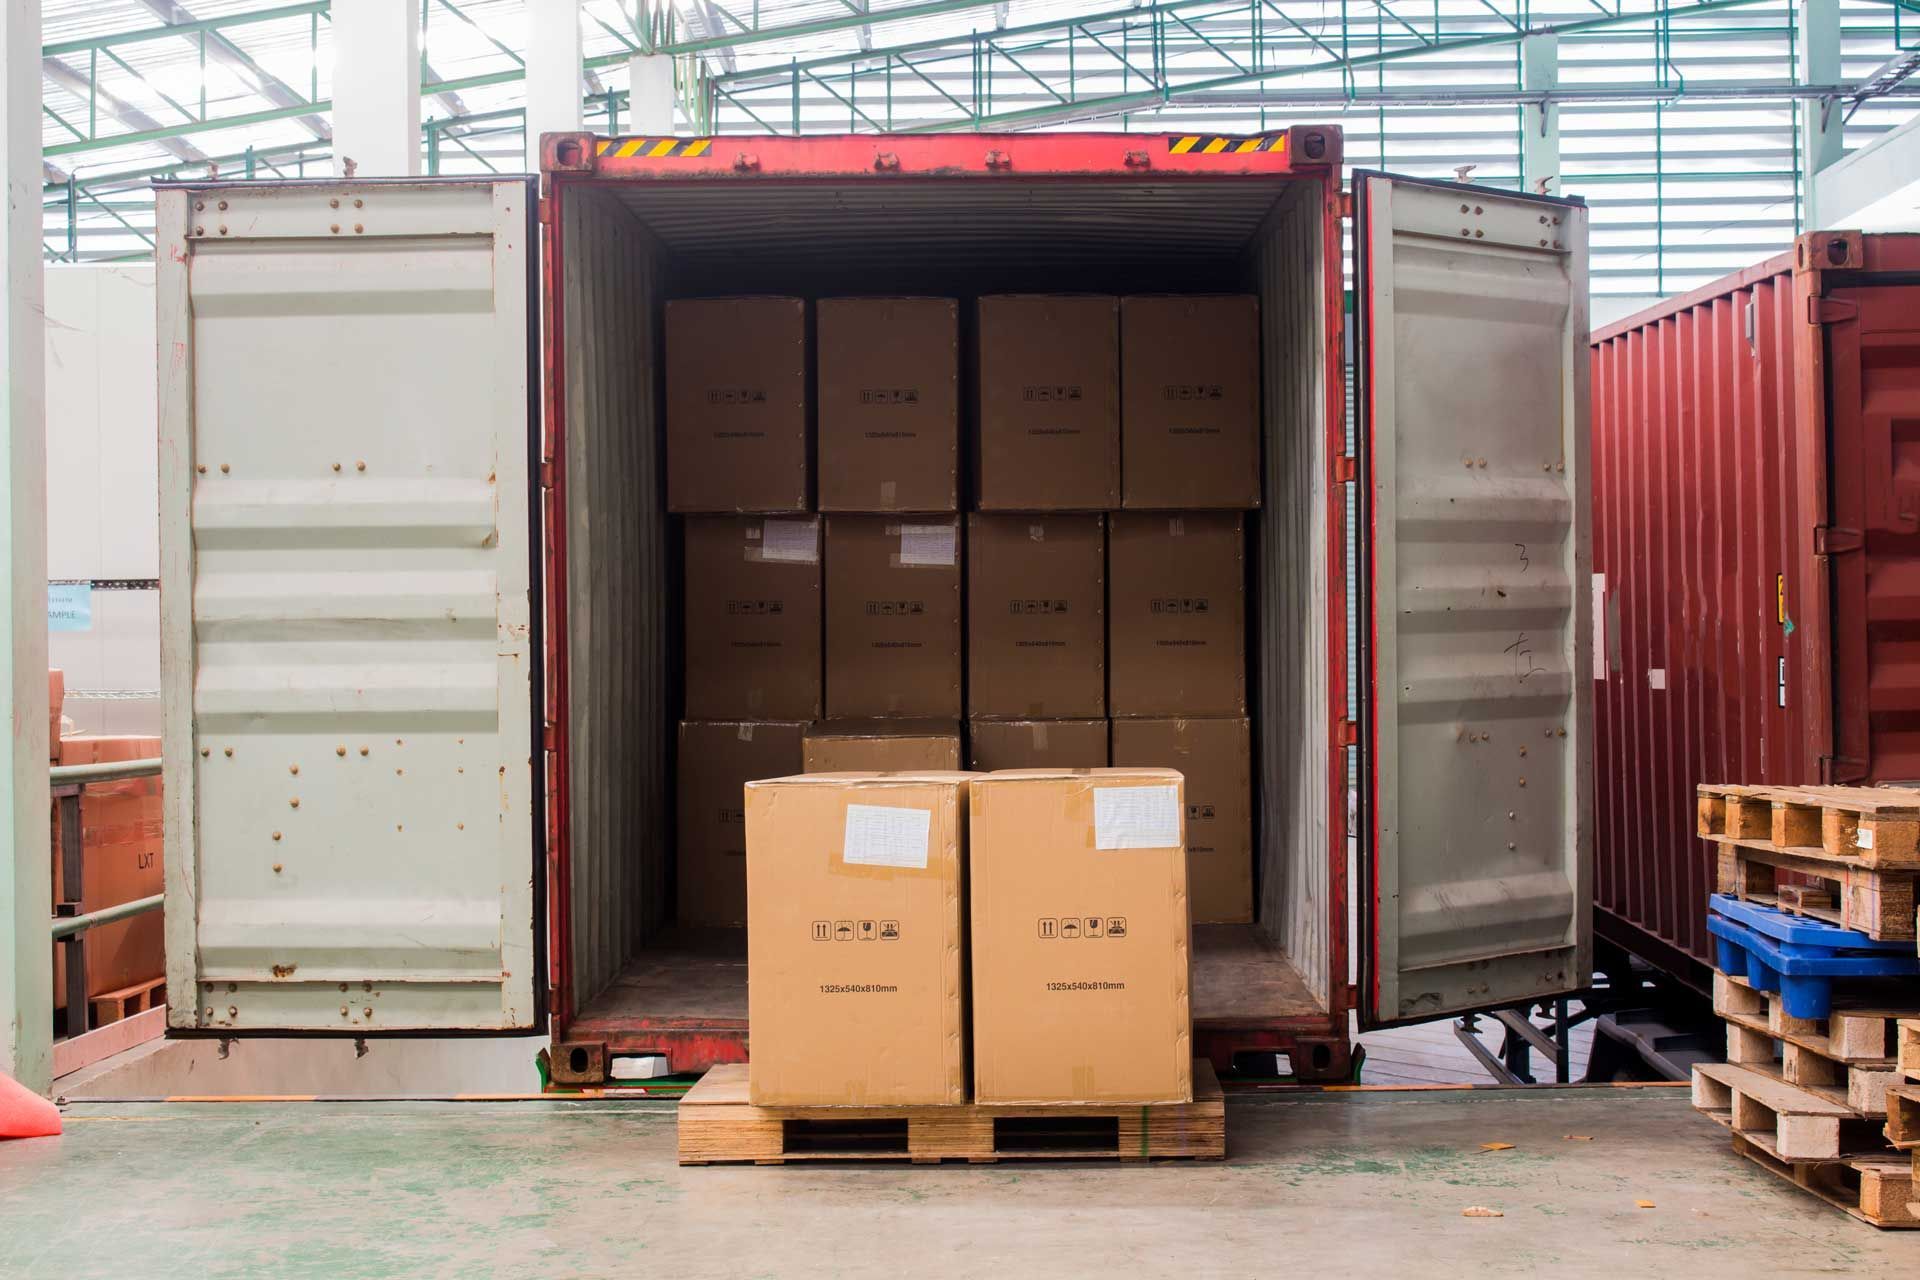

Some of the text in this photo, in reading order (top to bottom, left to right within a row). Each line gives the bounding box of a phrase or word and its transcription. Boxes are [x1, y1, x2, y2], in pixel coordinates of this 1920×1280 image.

[138, 852, 154, 869] LXT
[819, 983, 898, 994] 1325x540x810mm
[1046, 980, 1125, 992] 1325x540x810mm
